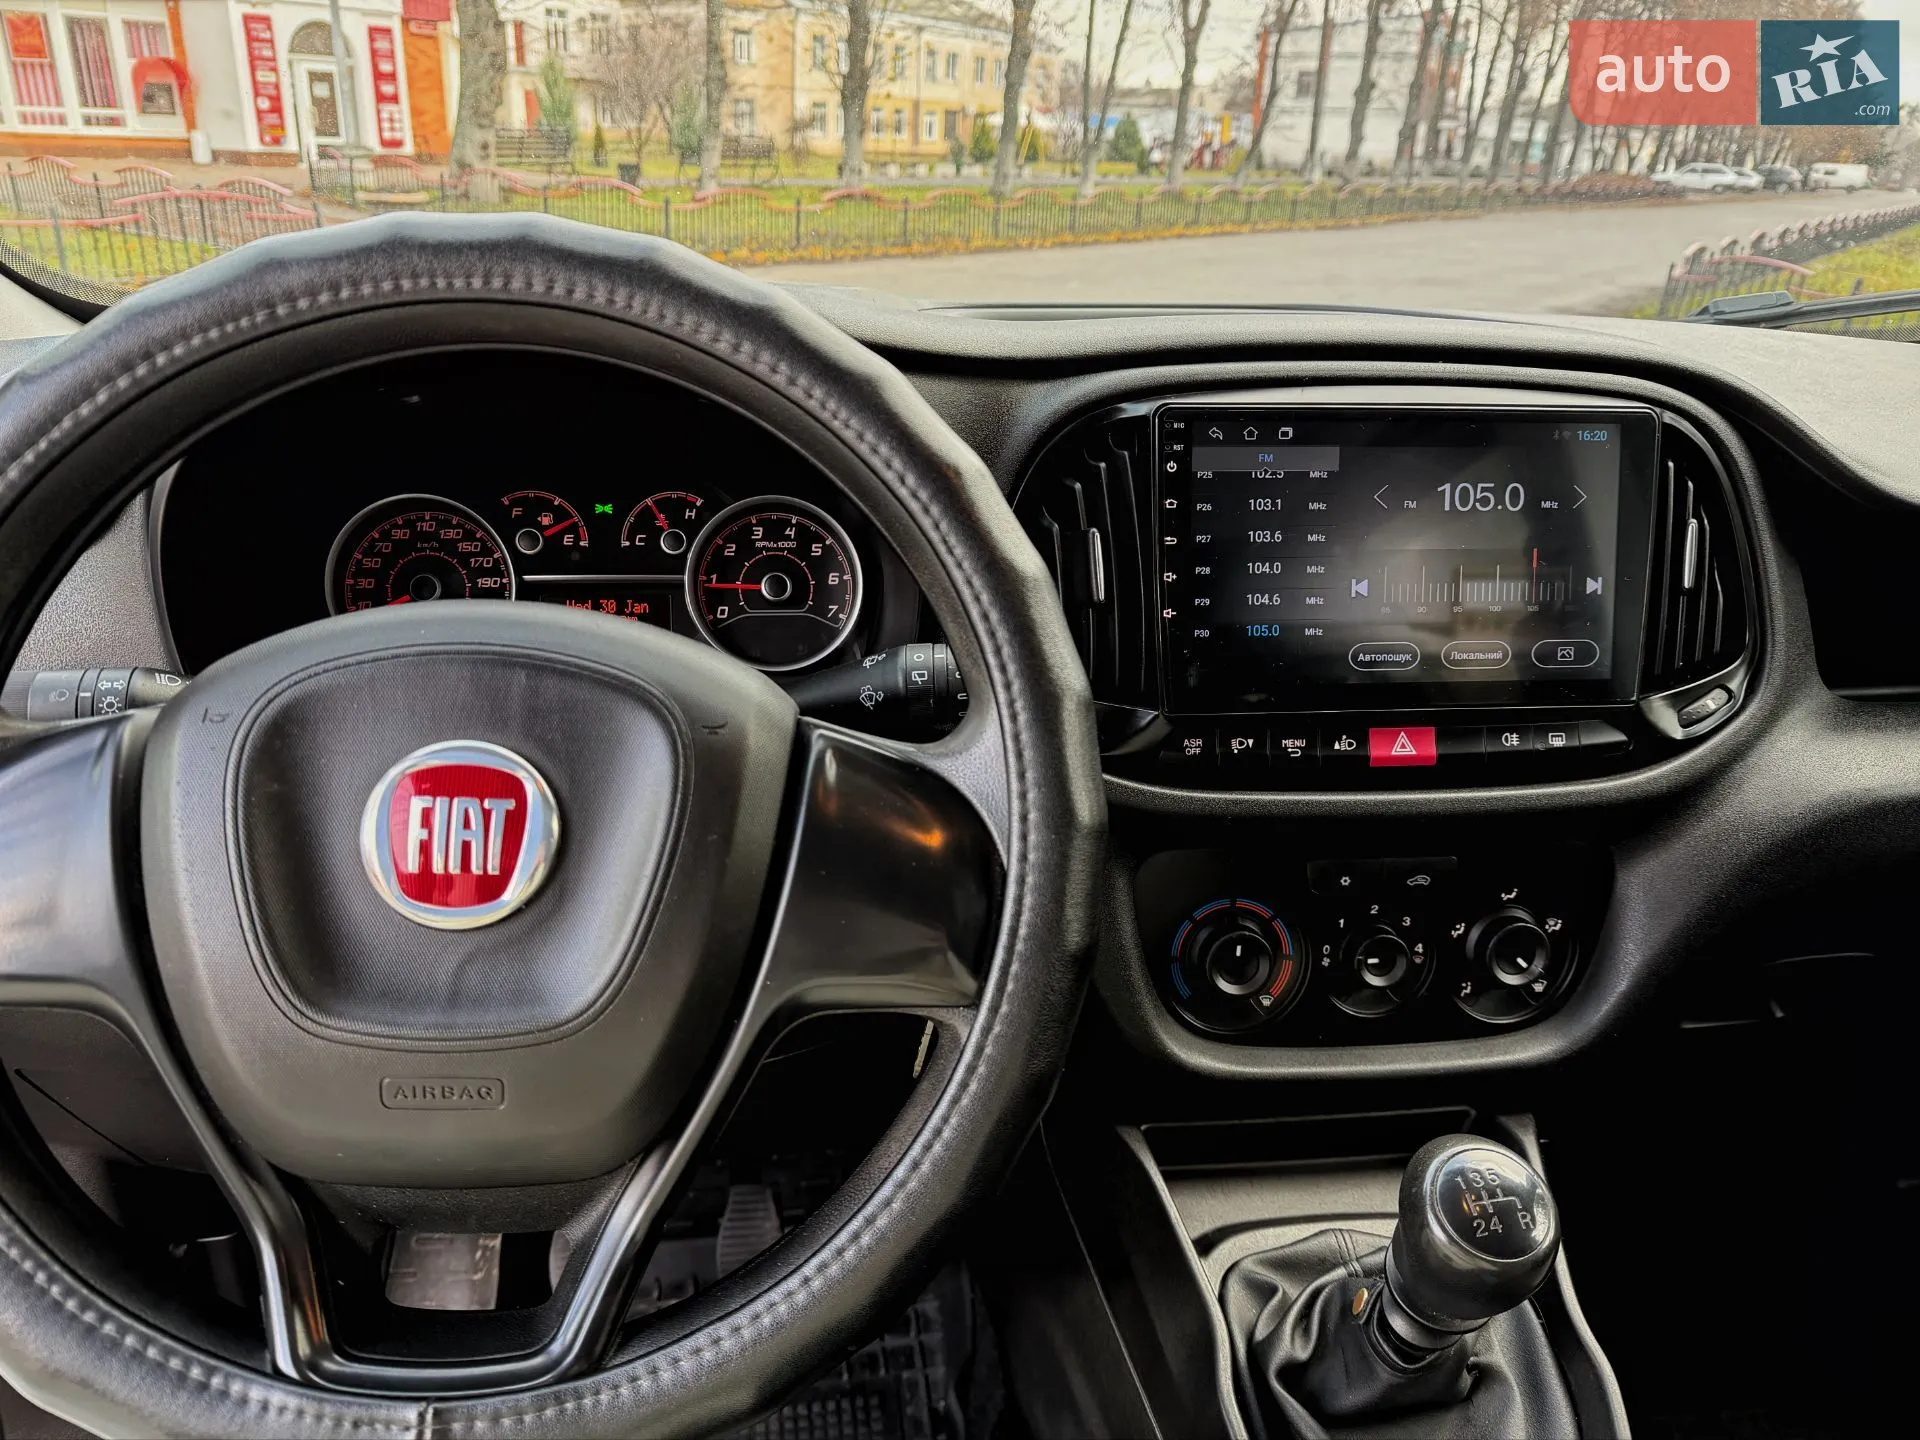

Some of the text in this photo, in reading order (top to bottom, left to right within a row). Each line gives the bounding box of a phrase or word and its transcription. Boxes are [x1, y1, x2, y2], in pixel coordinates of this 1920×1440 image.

[1577, 431, 1608, 441] 16:20
[1258, 454, 1273, 463] FM
[1197, 471, 1213, 479] P25
[1437, 482, 1525, 512] 105.0
[1197, 499, 1327, 511] P26 103.1 MHz
[511, 508, 522, 518] F
[684, 508, 696, 520] H
[416, 521, 435, 532] 110
[391, 529, 410, 540] 90
[440, 528, 463, 540] 130
[751, 527, 796, 539] 3 4
[1196, 531, 1326, 543] P27 103.6 MHz
[417, 541, 439, 549] km/h
[563, 534, 574, 546] E
[635, 534, 646, 546] C
[374, 542, 392, 553] 70
[457, 542, 481, 553] 150
[724, 544, 736, 556] 2
[811, 544, 823, 556] 5
[362, 558, 381, 569] 50
[469, 557, 493, 568] 170
[1195, 562, 1325, 575] P28 104.0 MHz
[356, 578, 375, 589] 30
[476, 577, 500, 588] 190
[709, 573, 717, 585] 1
[828, 572, 839, 585] 6
[599, 599, 617, 613] 30
[624, 599, 649, 613] Jan
[1195, 594, 1324, 606] P29 104.6 MHz
[716, 606, 729, 618] 0
[827, 605, 839, 618] 7
[1417, 605, 1427, 613] 90
[1453, 605, 1463, 613] 95
[1489, 604, 1501, 612] 100
[1527, 604, 1539, 612] 105
[1194, 625, 1323, 638] P30 105.0 MHz
[1358, 650, 1412, 662] Автопошук
[1450, 648, 1503, 660] Локальний
[1183, 738, 1203, 747] ASR
[1281, 738, 1306, 748] MENU
[1185, 747, 1201, 756] OFF
[406, 795, 517, 876] FIAT
[1370, 905, 1379, 915] 2
[1337, 918, 1345, 928] 1
[1402, 916, 1411, 926] 3
[1414, 943, 1424, 953] 4
[393, 1084, 494, 1101] AIRBAG
[1455, 1168, 1500, 1190] 1 3 5
[1517, 1210, 1534, 1230] R
[1472, 1215, 1503, 1238] 2 4
